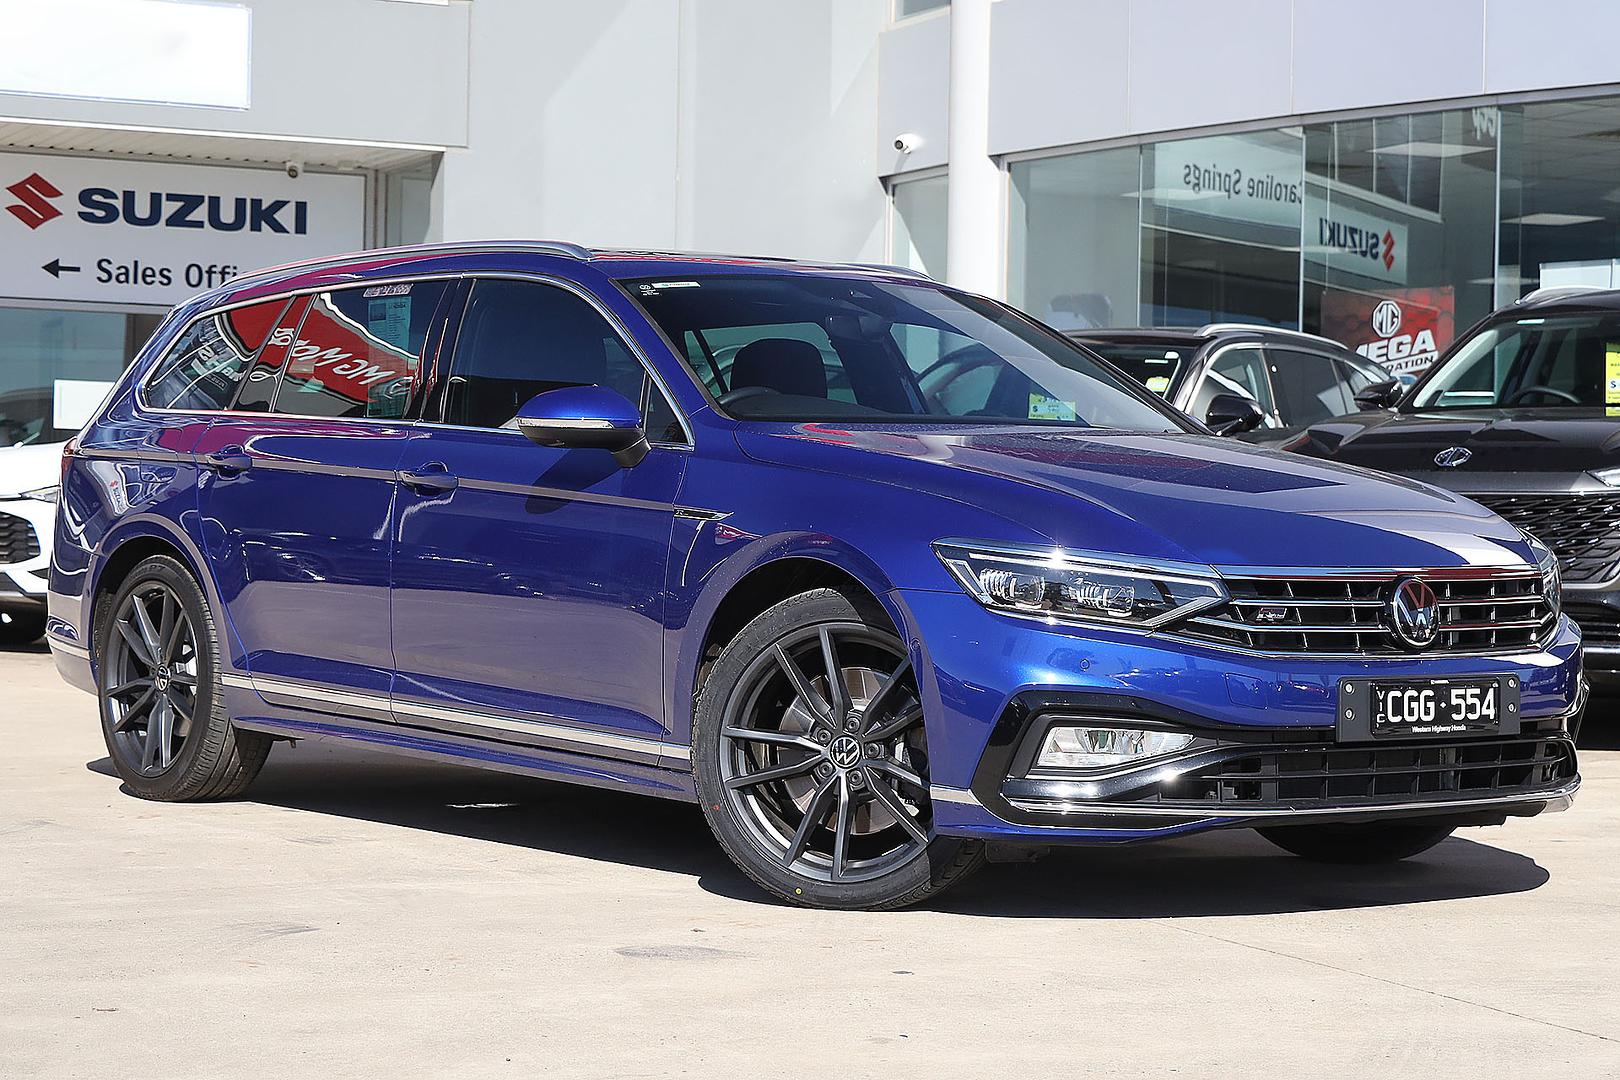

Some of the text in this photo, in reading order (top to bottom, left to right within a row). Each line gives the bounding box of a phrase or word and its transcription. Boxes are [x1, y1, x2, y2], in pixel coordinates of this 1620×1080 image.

[77, 187, 308, 235] SUZUKI
[96, 258, 172, 287] Sales
[1387, 688, 1496, 722] CGG 554
